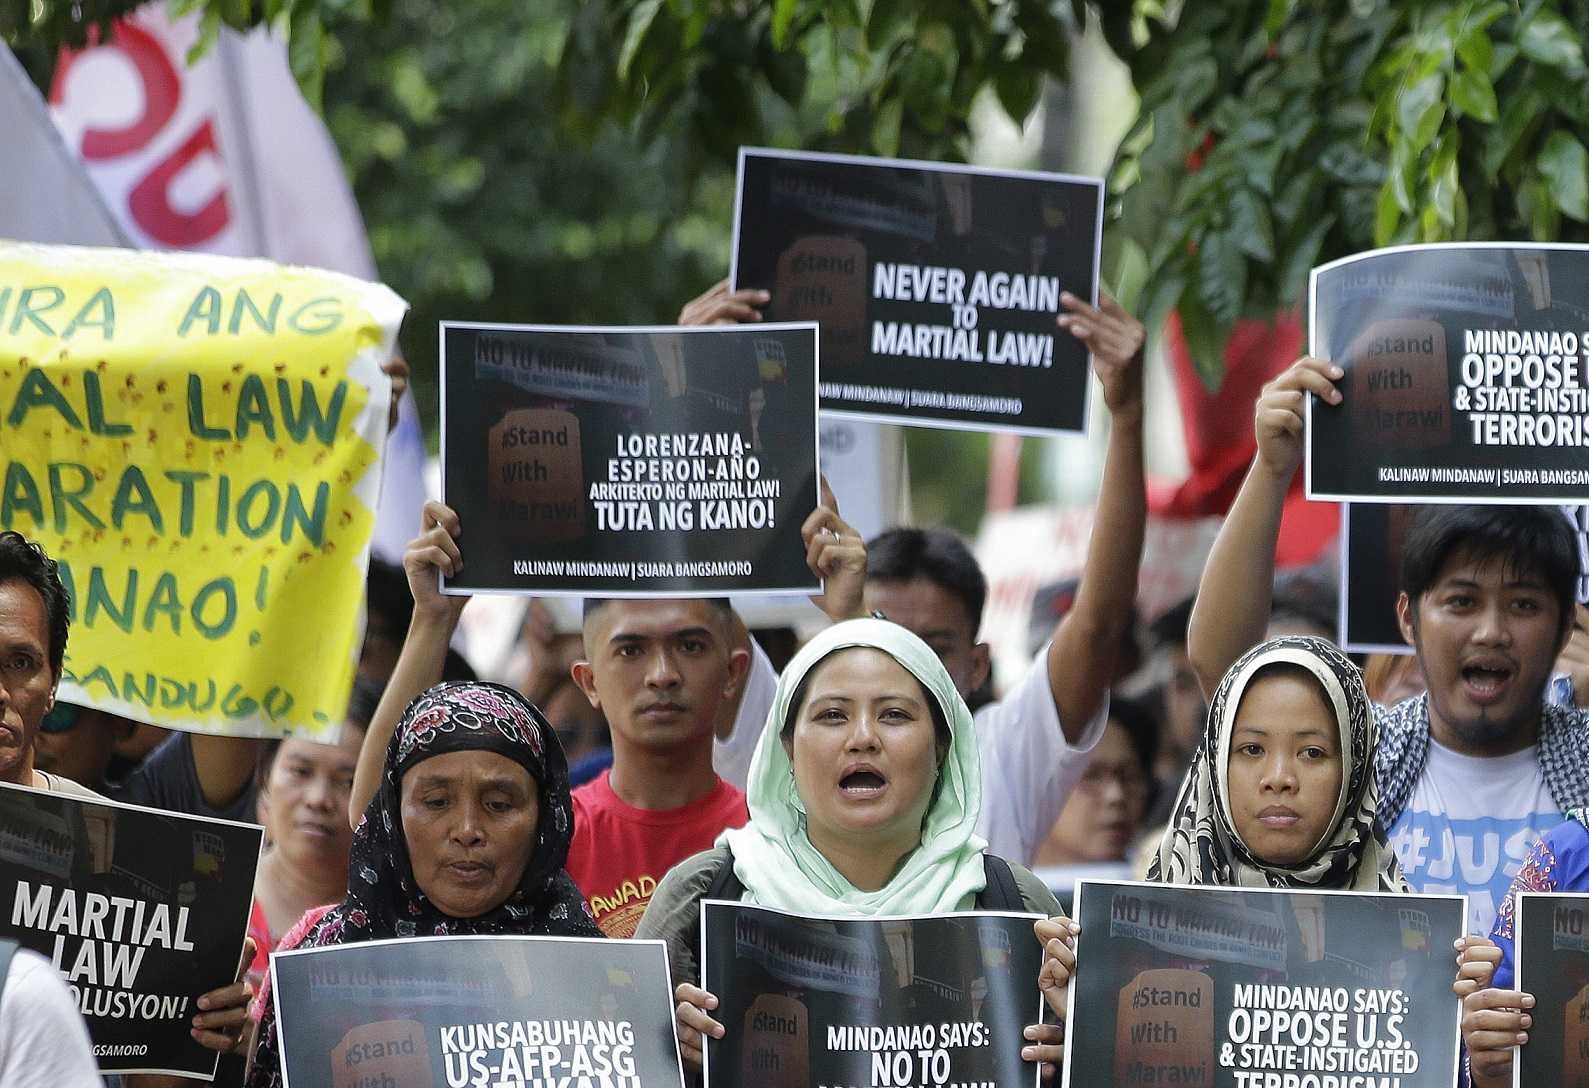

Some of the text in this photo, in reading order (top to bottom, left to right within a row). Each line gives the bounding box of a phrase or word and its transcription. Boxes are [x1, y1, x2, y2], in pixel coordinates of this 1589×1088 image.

[872, 263, 966, 305] NEVER
[971, 270, 1060, 312] AGAIN
[177, 284, 344, 339] ANG
[952, 304, 978, 329] TO
[872, 321, 1054, 368] MARTIAL LAW!
[1464, 330, 1578, 357] MINDANAO
[1461, 354, 1578, 389] OPPOSE
[842, 384, 904, 404] MINDANAW
[1456, 386, 1471, 411] &
[187, 373, 347, 447] LAW
[617, 433, 751, 458] LORENZANA-
[608, 454, 760, 482] ESPERON-AÑO
[1379, 467, 1429, 483] KALINAW
[1432, 469, 1495, 484] MINDANAW
[1503, 469, 1539, 484] SUARA
[589, 480, 780, 500] ARKITEKTO NG MARTIAL LAW!
[594, 501, 655, 531] TUTA
[659, 501, 694, 531] NG
[700, 500, 776, 529] KANO!
[513, 561, 752, 577] KALINAW MINDANAW SUARA BANGSAMORO
[11, 880, 195, 952] MARTIAL
[1555, 907, 1583, 935] NO
[52, 934, 146, 989] LAW
[1233, 984, 1410, 1015] MINDANAO SAYS:
[440, 1020, 635, 1055] KUNSABUHANG
[826, 1022, 991, 1051] MINDANAO SAYS:
[1228, 1008, 1412, 1050] OPPOSE U.S.
[444, 1044, 635, 1088] US-AFP-ASG
[871, 1049, 951, 1087] NO TO
[1219, 1042, 1420, 1075] & STATE-INSTIGATED
